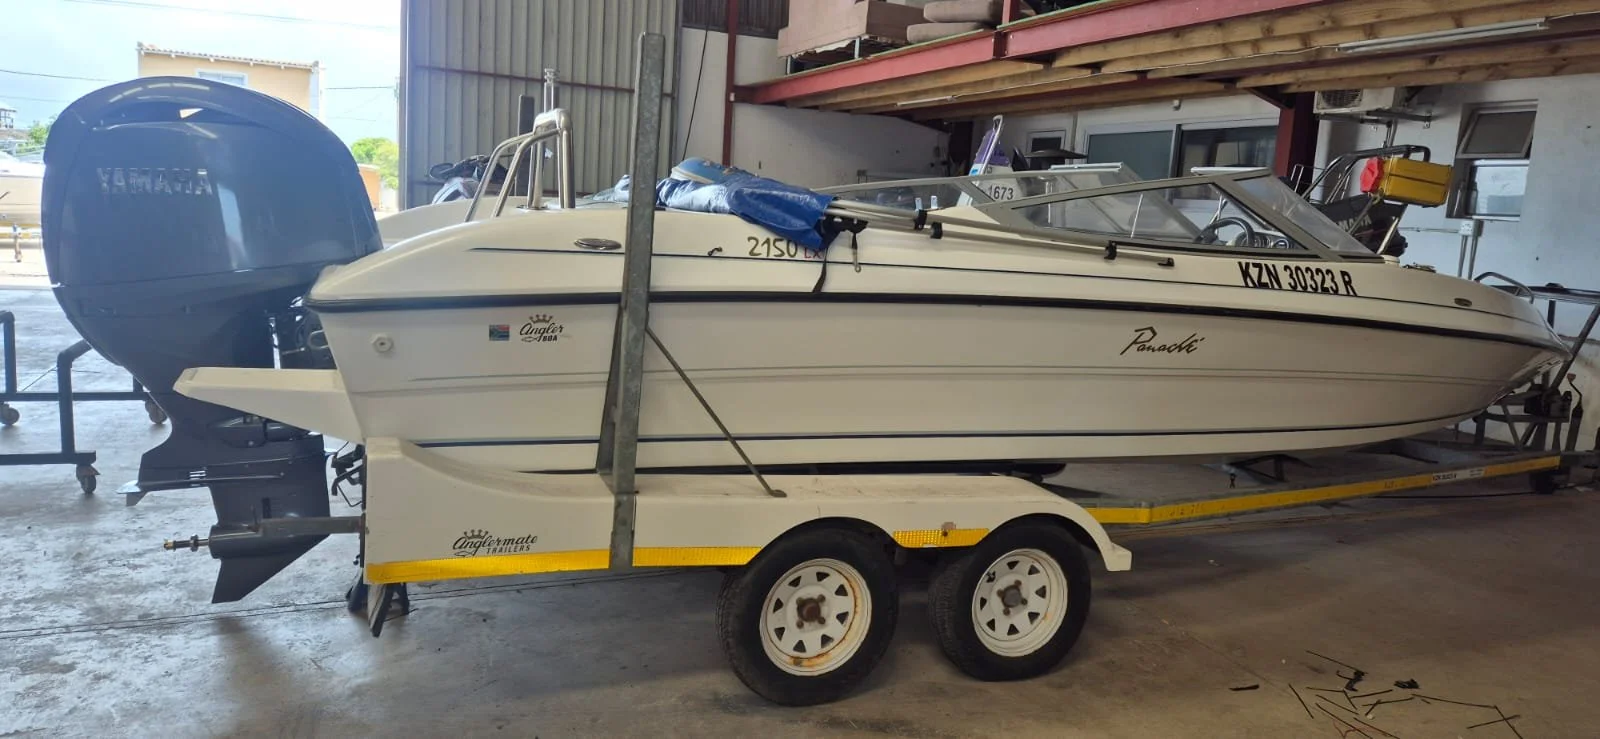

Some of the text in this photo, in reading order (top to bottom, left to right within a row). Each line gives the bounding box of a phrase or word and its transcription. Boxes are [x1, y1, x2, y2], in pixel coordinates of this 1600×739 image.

[97, 167, 213, 194] YAMAHA
[989, 185, 1014, 200] 1673
[747, 236, 798, 258] 2150
[1238, 261, 1358, 297] KZN 30323 R
[519, 322, 564, 342] Angler
[452, 533, 538, 556] Anglermate
[486, 544, 531, 555] TRAILERS
